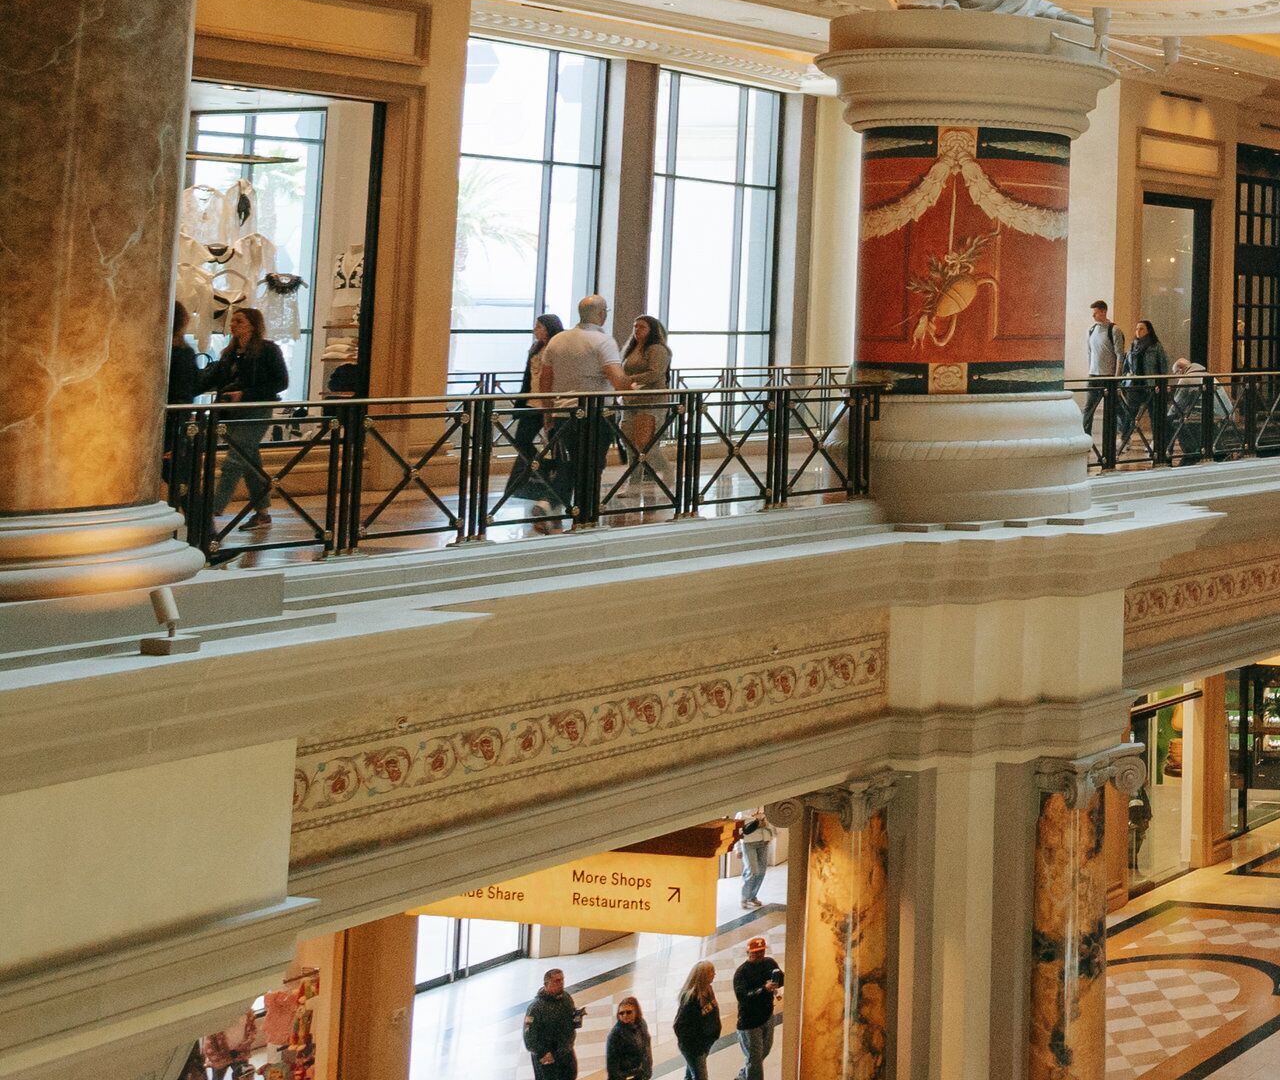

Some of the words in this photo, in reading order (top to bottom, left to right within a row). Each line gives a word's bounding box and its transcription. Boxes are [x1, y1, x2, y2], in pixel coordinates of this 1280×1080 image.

[572, 869, 607, 884] More
[611, 872, 652, 890] Shops
[487, 885, 525, 901] Share
[572, 892, 651, 911] Restaurants
